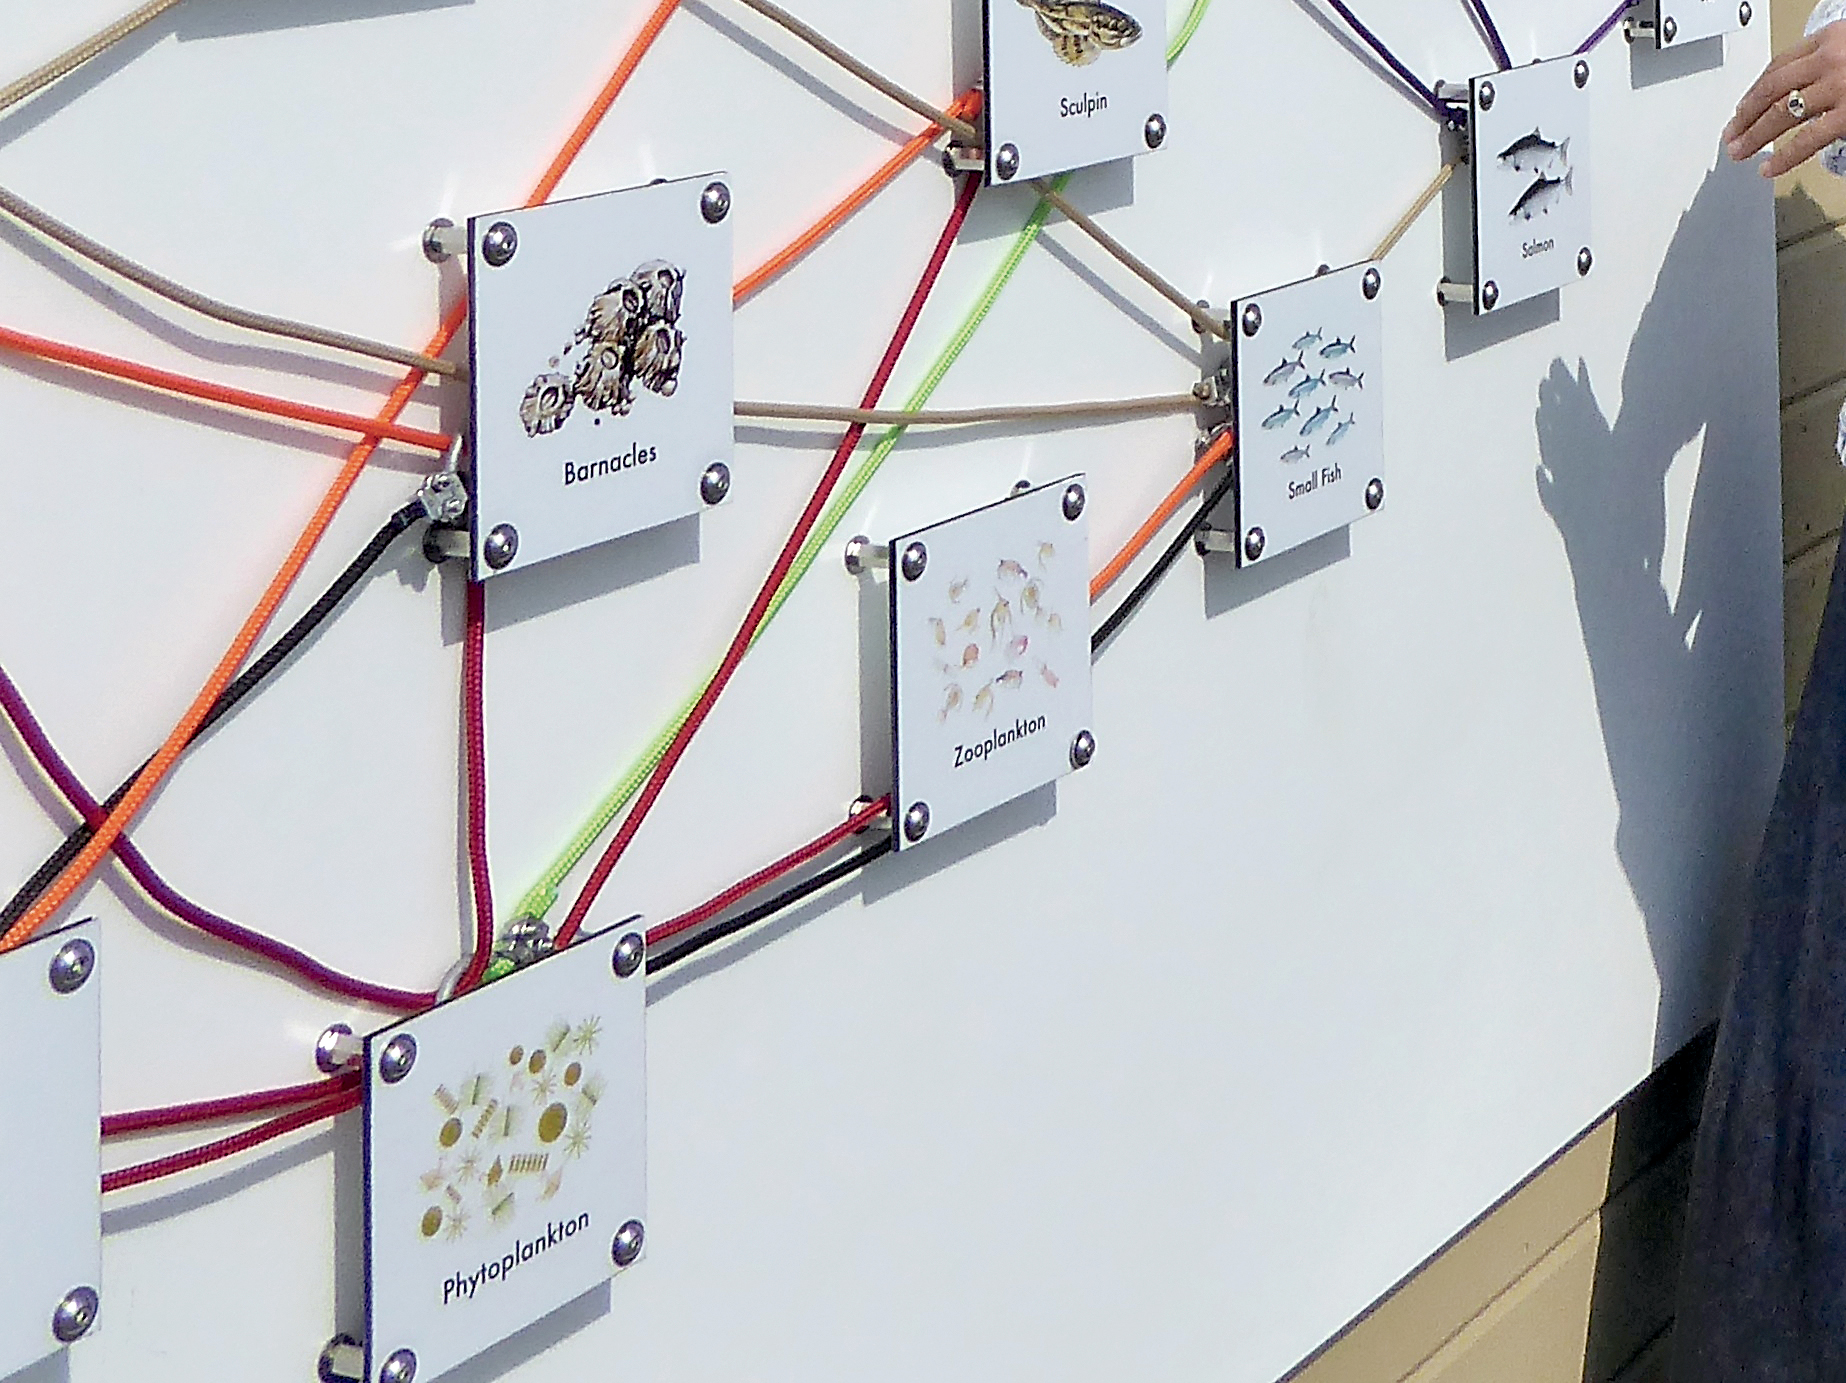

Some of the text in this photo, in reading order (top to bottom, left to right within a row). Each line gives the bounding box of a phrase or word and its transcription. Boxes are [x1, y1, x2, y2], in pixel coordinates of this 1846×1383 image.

[1060, 91, 1108, 119] Sculpin
[1522, 238, 1555, 259] Salmon
[564, 441, 657, 486] Barnacles
[1288, 462, 1342, 500] Small Fish
[954, 715, 1046, 768] Zooplankton
[443, 1212, 590, 1305] Phytoplankton
